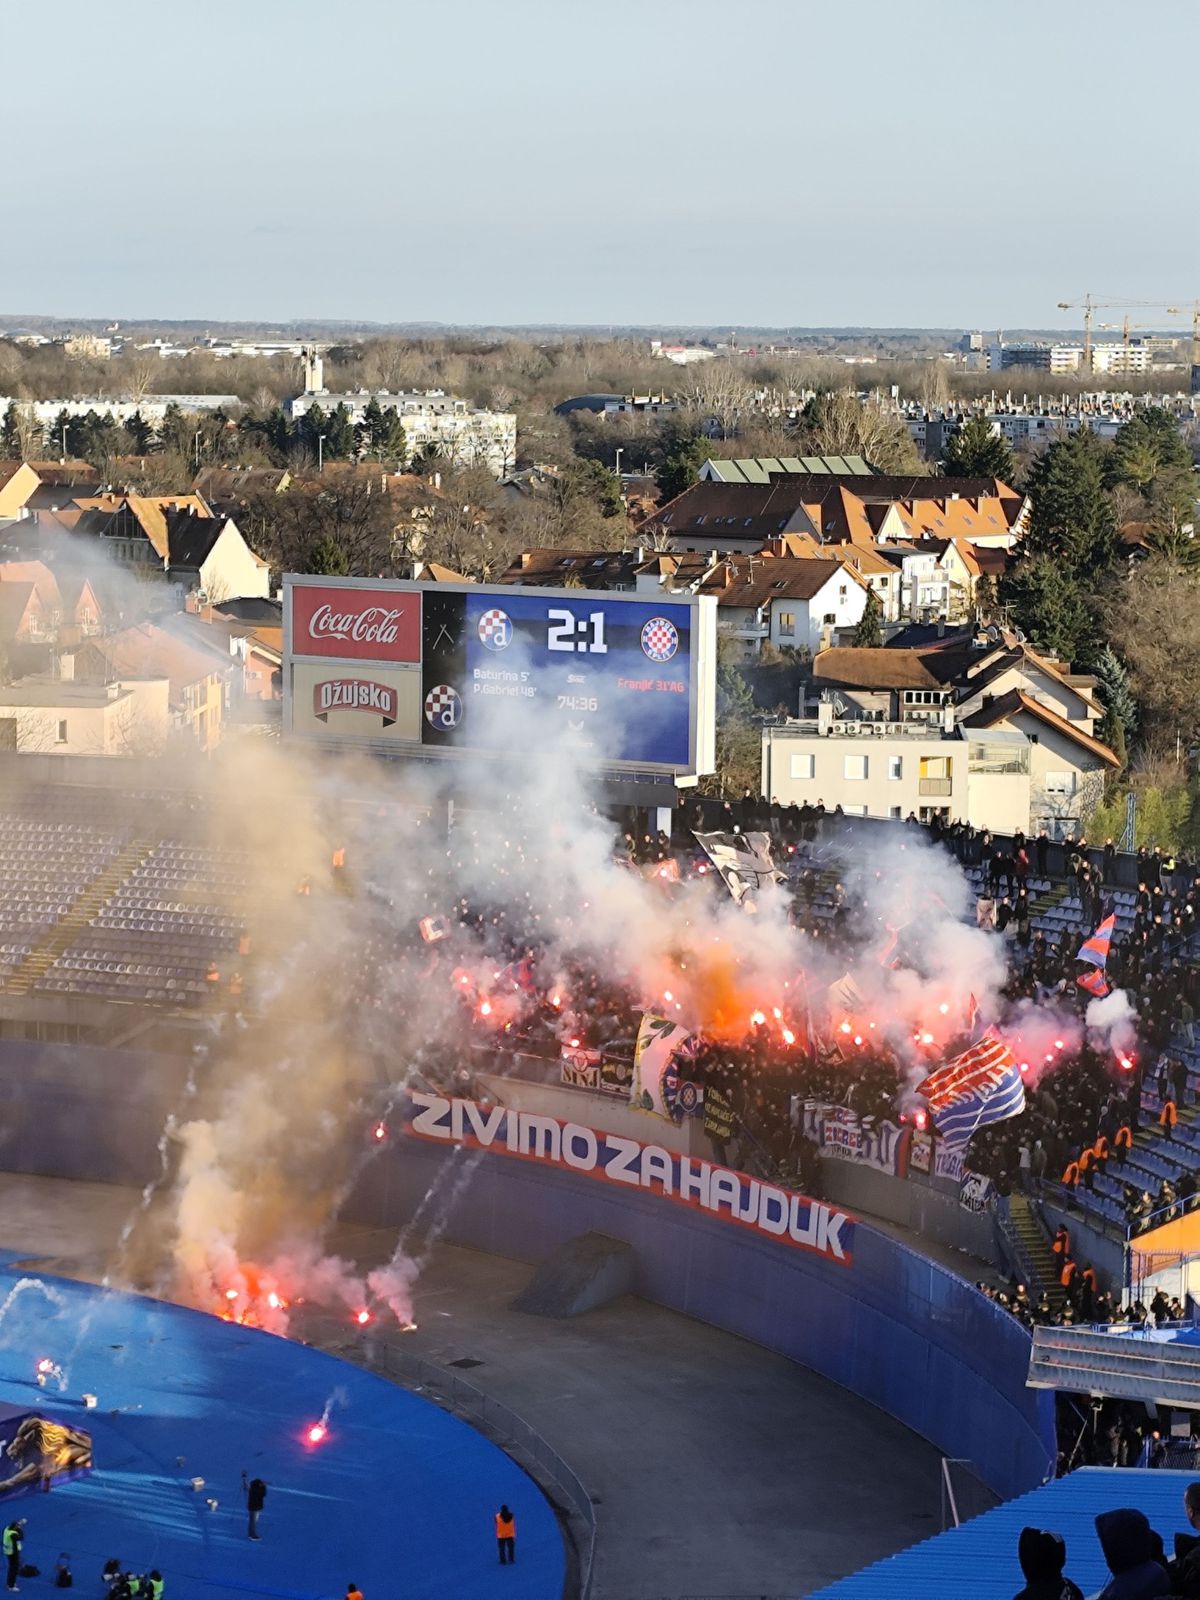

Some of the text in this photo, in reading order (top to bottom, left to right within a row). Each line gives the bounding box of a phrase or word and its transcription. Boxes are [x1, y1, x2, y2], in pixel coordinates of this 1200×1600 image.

[308, 604, 405, 643] Coca-Cola
[547, 609, 608, 653] 2:1
[473, 668, 518, 682] Baturina
[320, 681, 392, 712] Ožujsko
[557, 695, 598, 711] 74:36
[605, 1134, 673, 1196] ZA
[679, 1154, 848, 1260] HAJDUK
